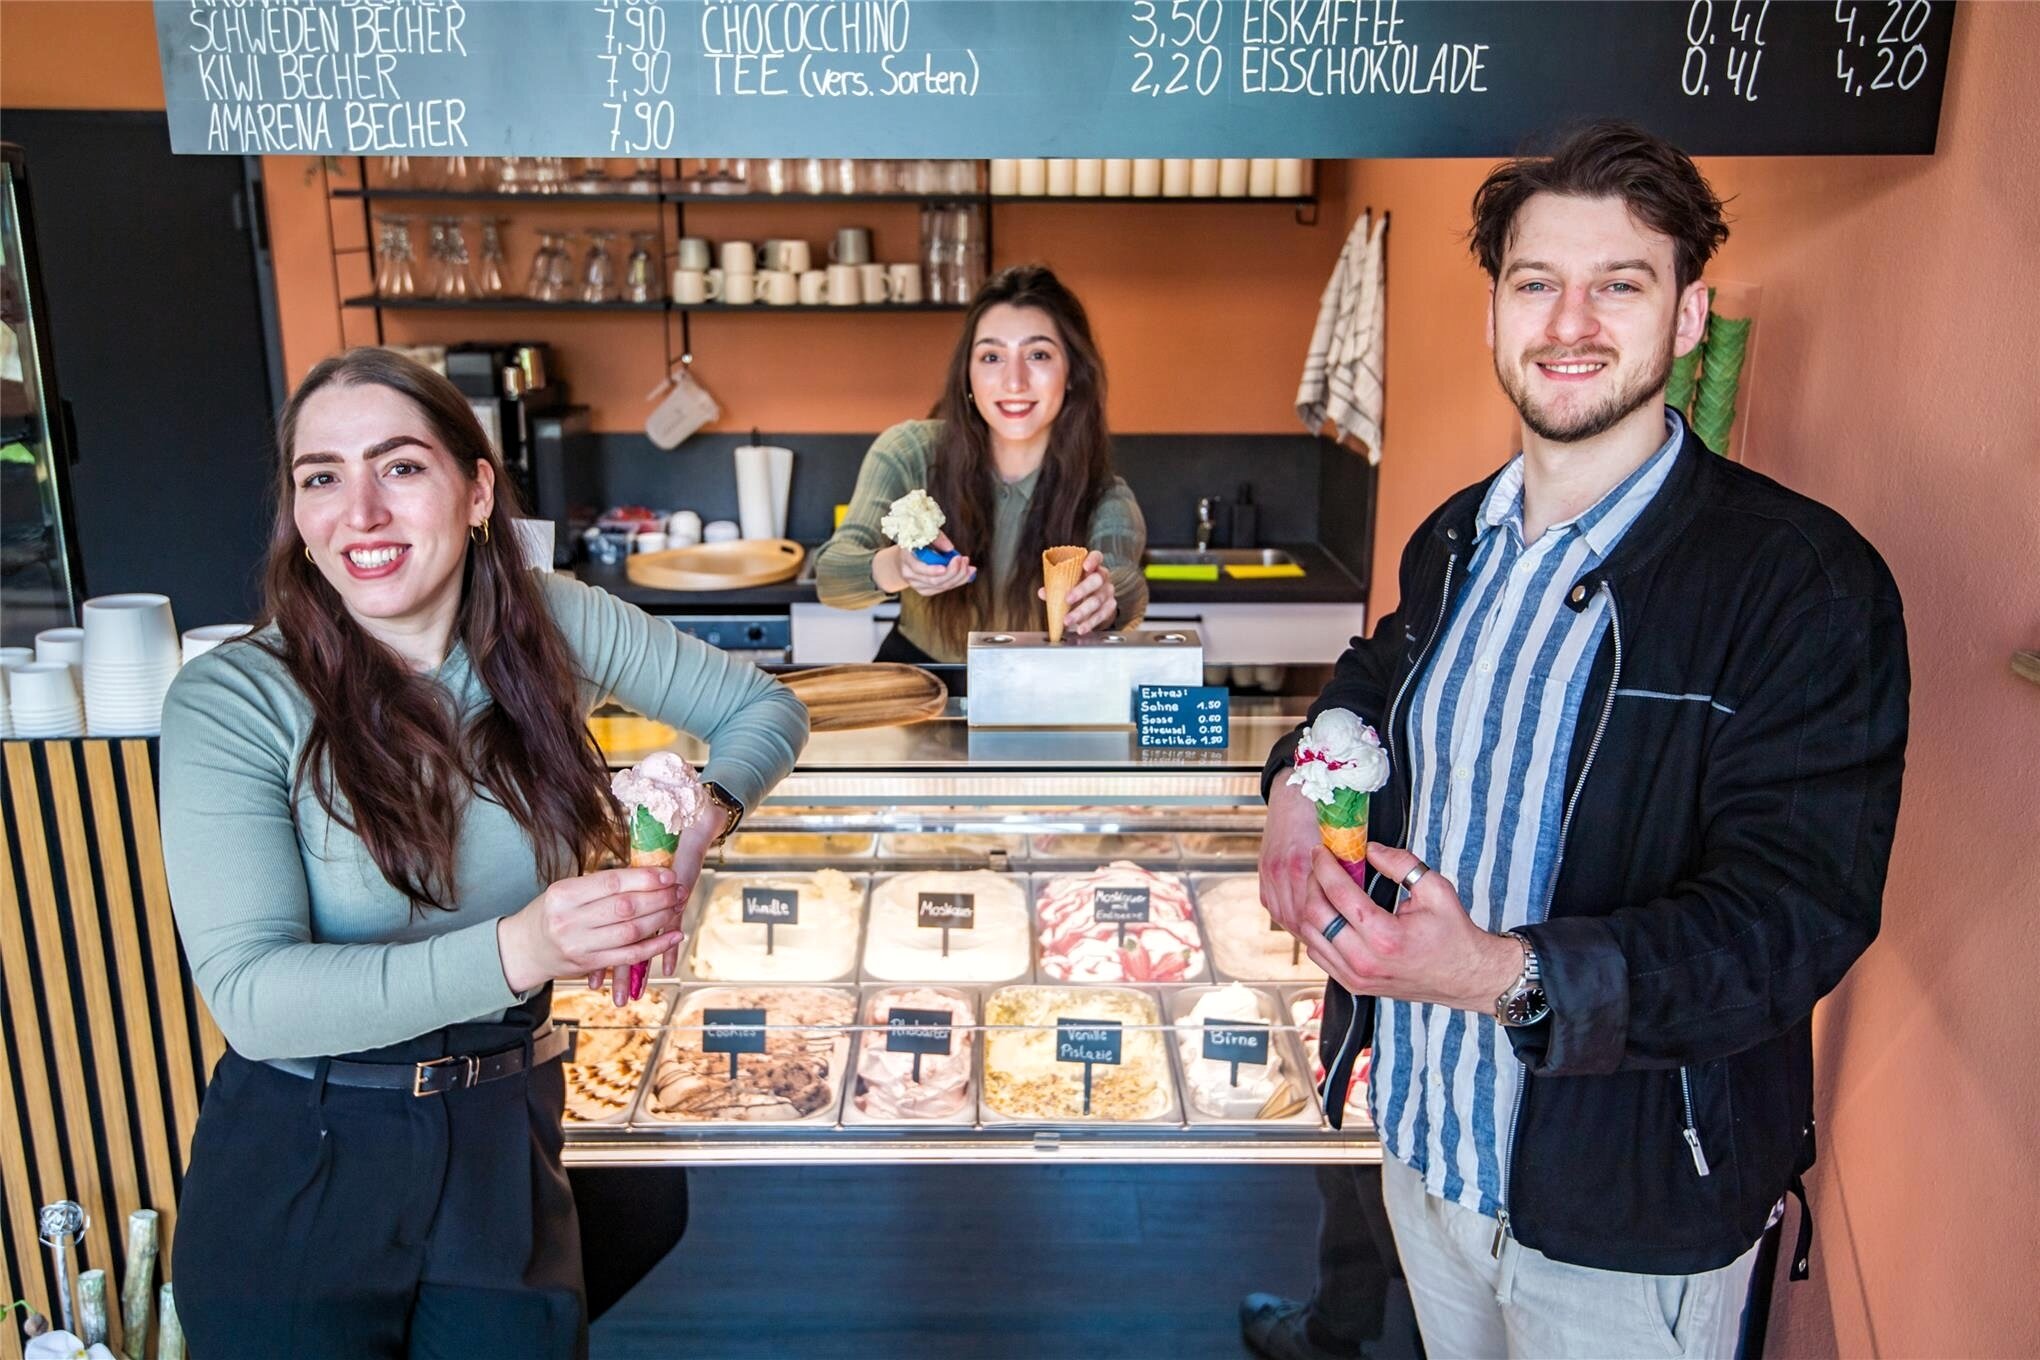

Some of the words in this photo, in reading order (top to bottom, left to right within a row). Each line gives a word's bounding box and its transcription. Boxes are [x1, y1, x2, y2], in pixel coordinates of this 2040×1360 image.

[190, 7, 339, 54] SCHWEDEN
[352, 6, 467, 56] BECHER
[595, 6, 666, 55] 7,90
[702, 1, 909, 54] CHOCOCCHINO
[1129, 0, 1222, 48] 3,50
[1243, 0, 1404, 46] EISKAFFEE
[198, 53, 263, 101] KIWI
[279, 52, 401, 100] BECHER
[597, 51, 671, 101] 7,90
[703, 52, 788, 95] TEE
[799, 52, 874, 97] (vers.
[880, 49, 980, 97] Sorten)
[1130, 45, 1222, 97] 2,20
[1242, 43, 1490, 96] EISSCHOKOLADE
[208, 101, 333, 152] AMARENA
[345, 99, 468, 151] BECHER
[603, 101, 674, 153] 7,90
[1141, 687, 1188, 699] Extras:
[1210, 1030, 1259, 1047] Birne
